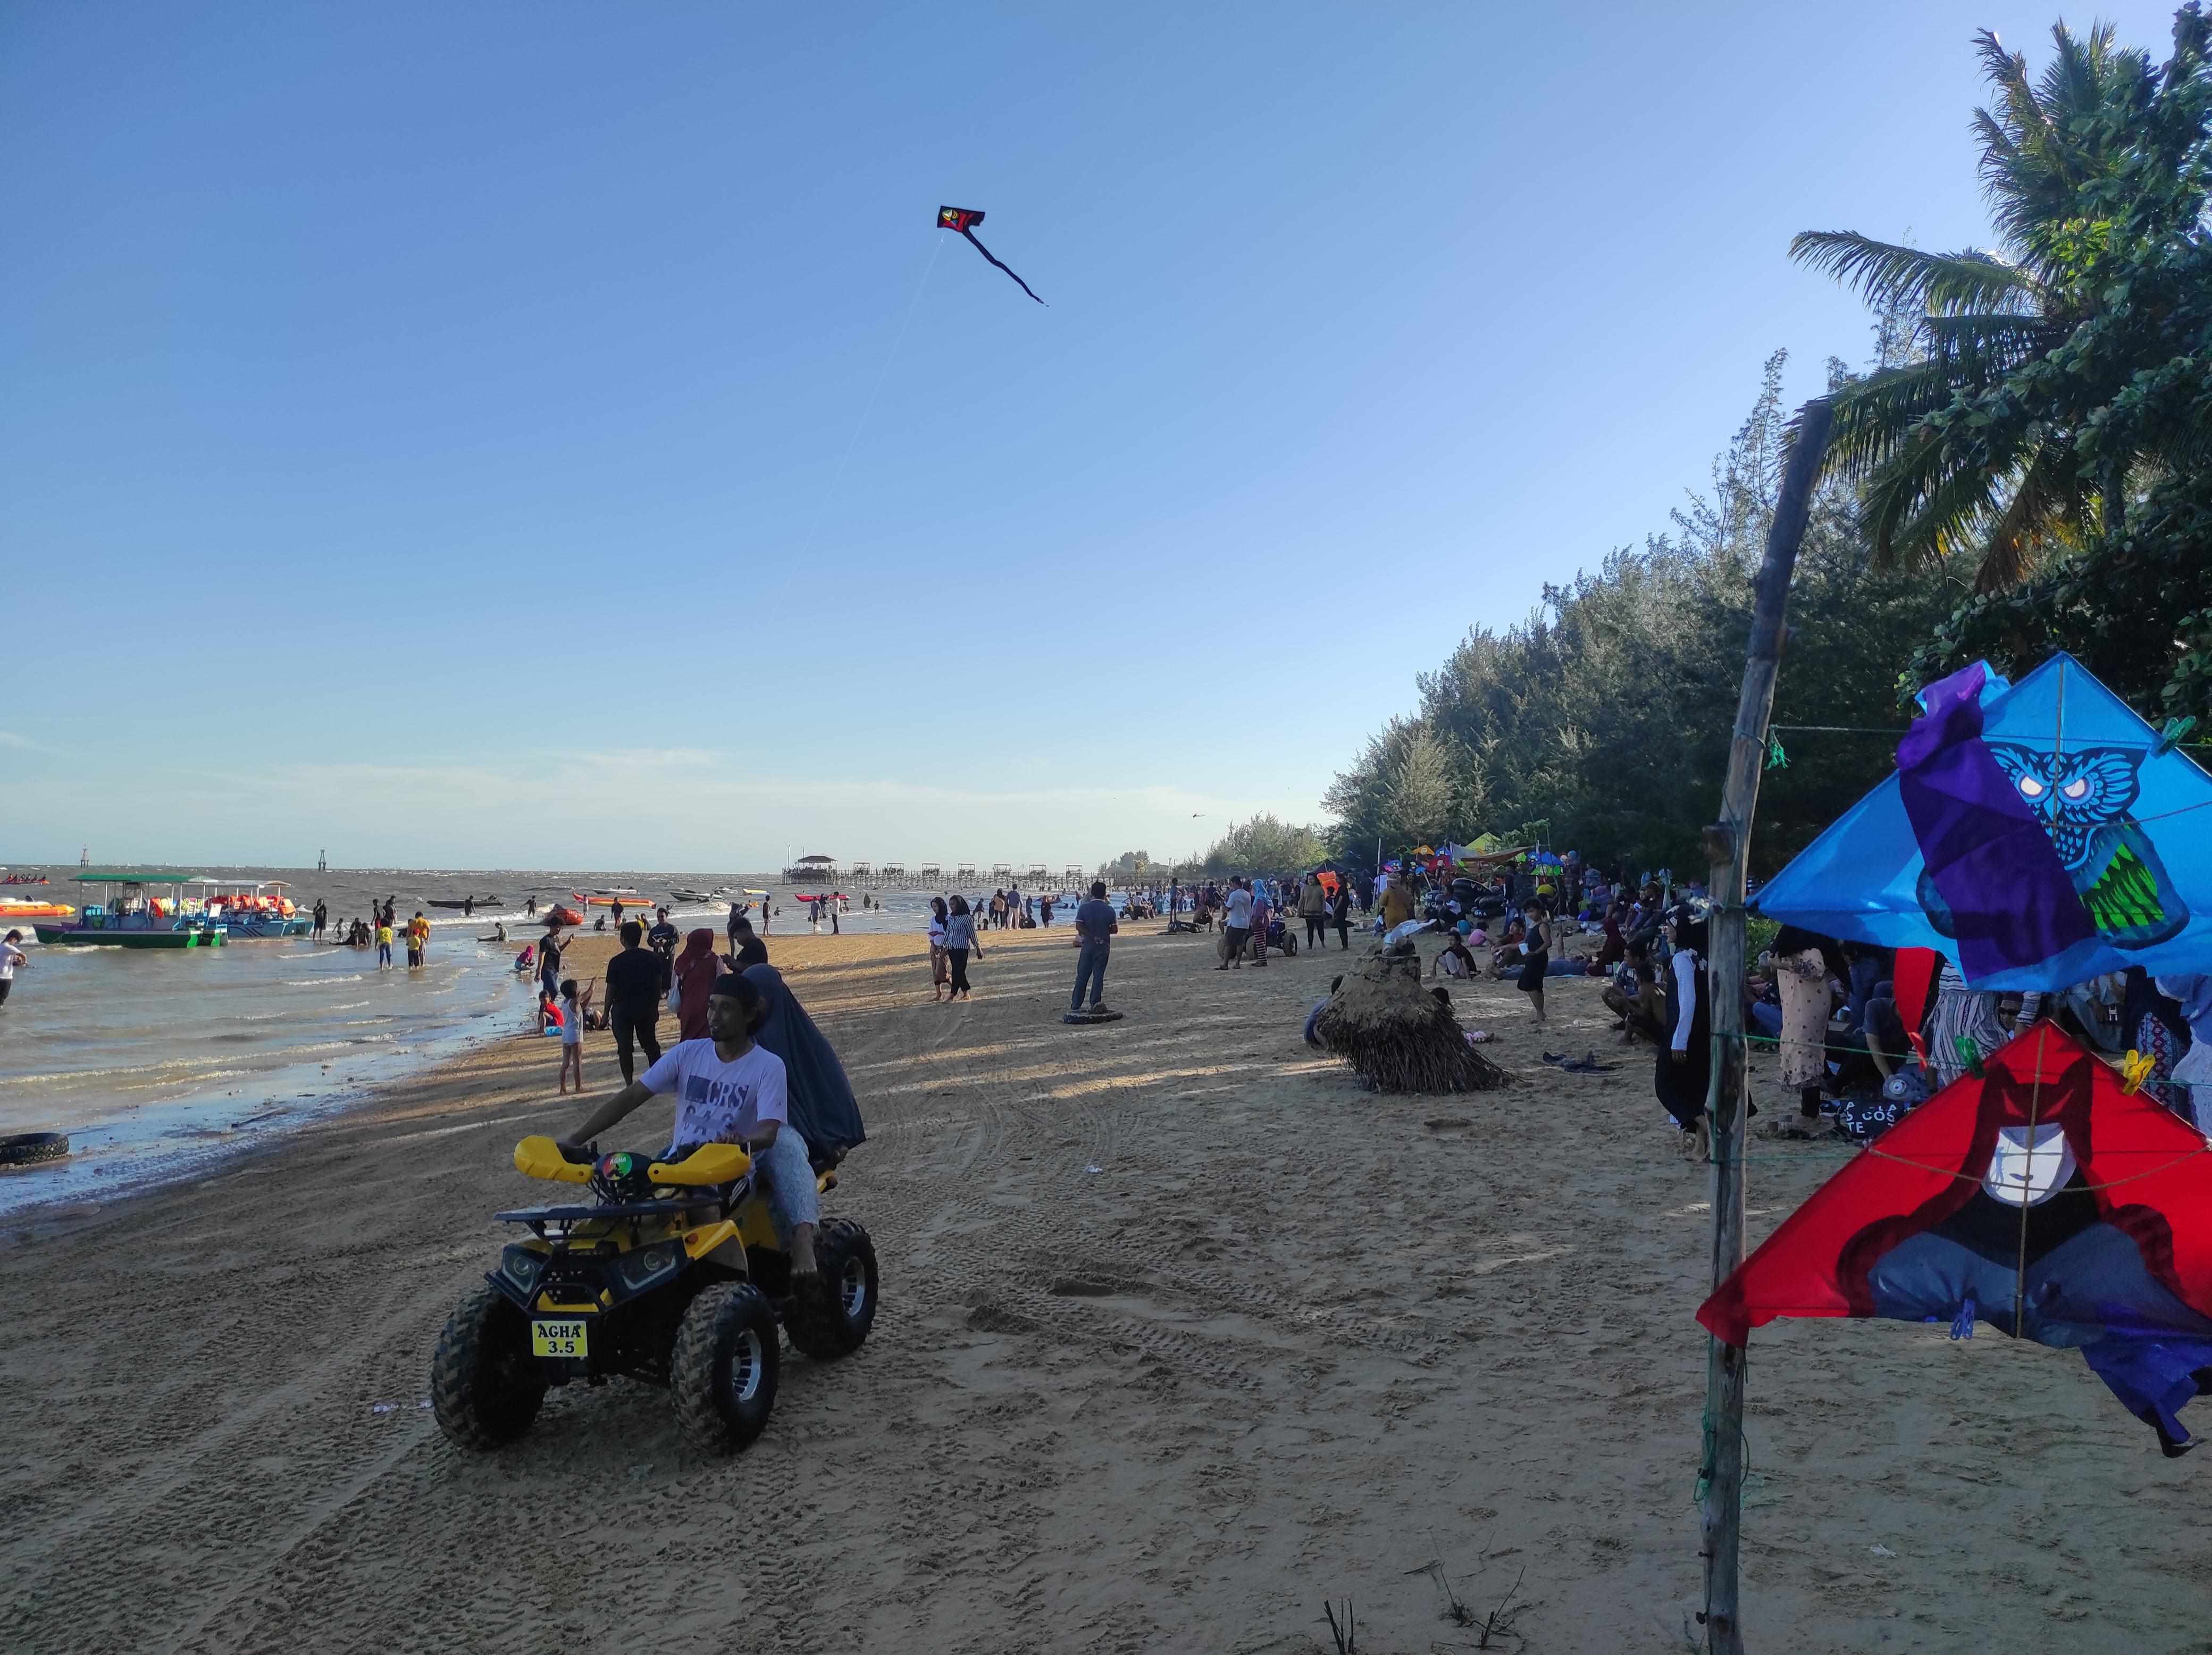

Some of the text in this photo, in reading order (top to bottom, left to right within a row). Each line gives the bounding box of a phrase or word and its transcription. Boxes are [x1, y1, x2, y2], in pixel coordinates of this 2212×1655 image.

[609, 1156, 626, 1166] AGHA
[538, 1325, 581, 1338] AGHA
[548, 1341, 575, 1353] 3.5
